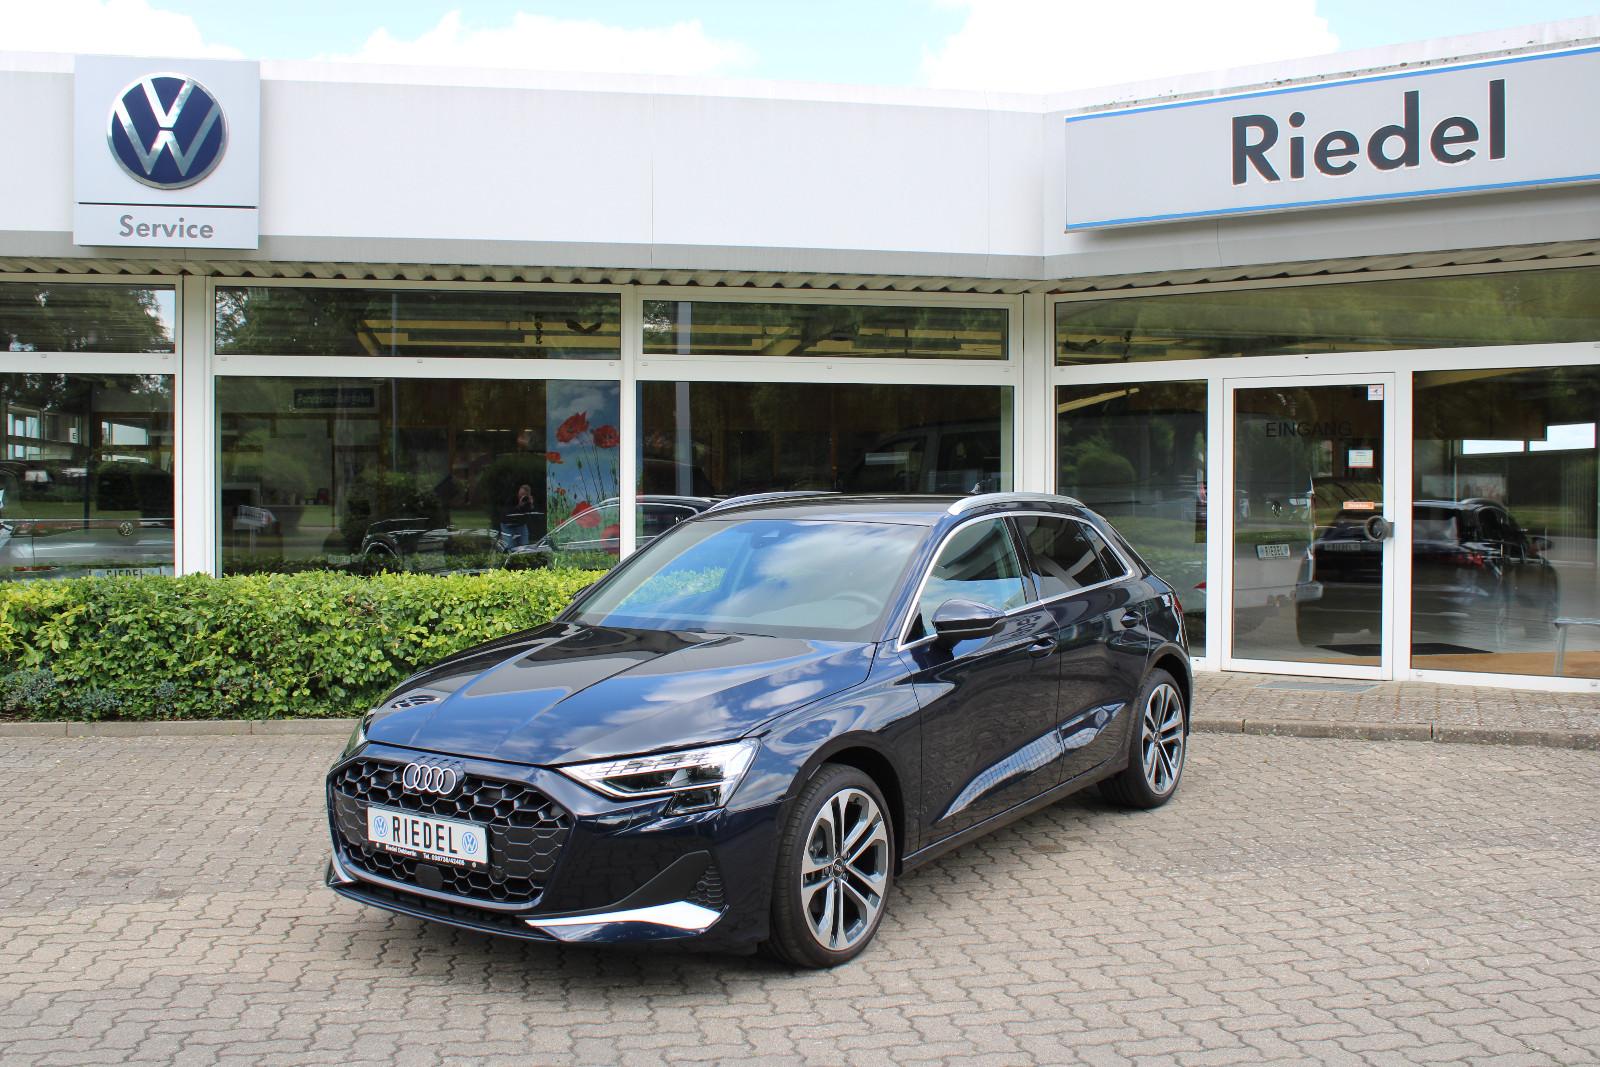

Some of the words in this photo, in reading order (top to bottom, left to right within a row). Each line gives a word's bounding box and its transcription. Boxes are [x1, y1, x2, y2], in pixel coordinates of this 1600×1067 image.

[1232, 79, 1506, 185] Riedel
[119, 214, 214, 239] Service
[1265, 421, 1352, 437] EINGANG
[392, 815, 458, 854] RIEDEL
